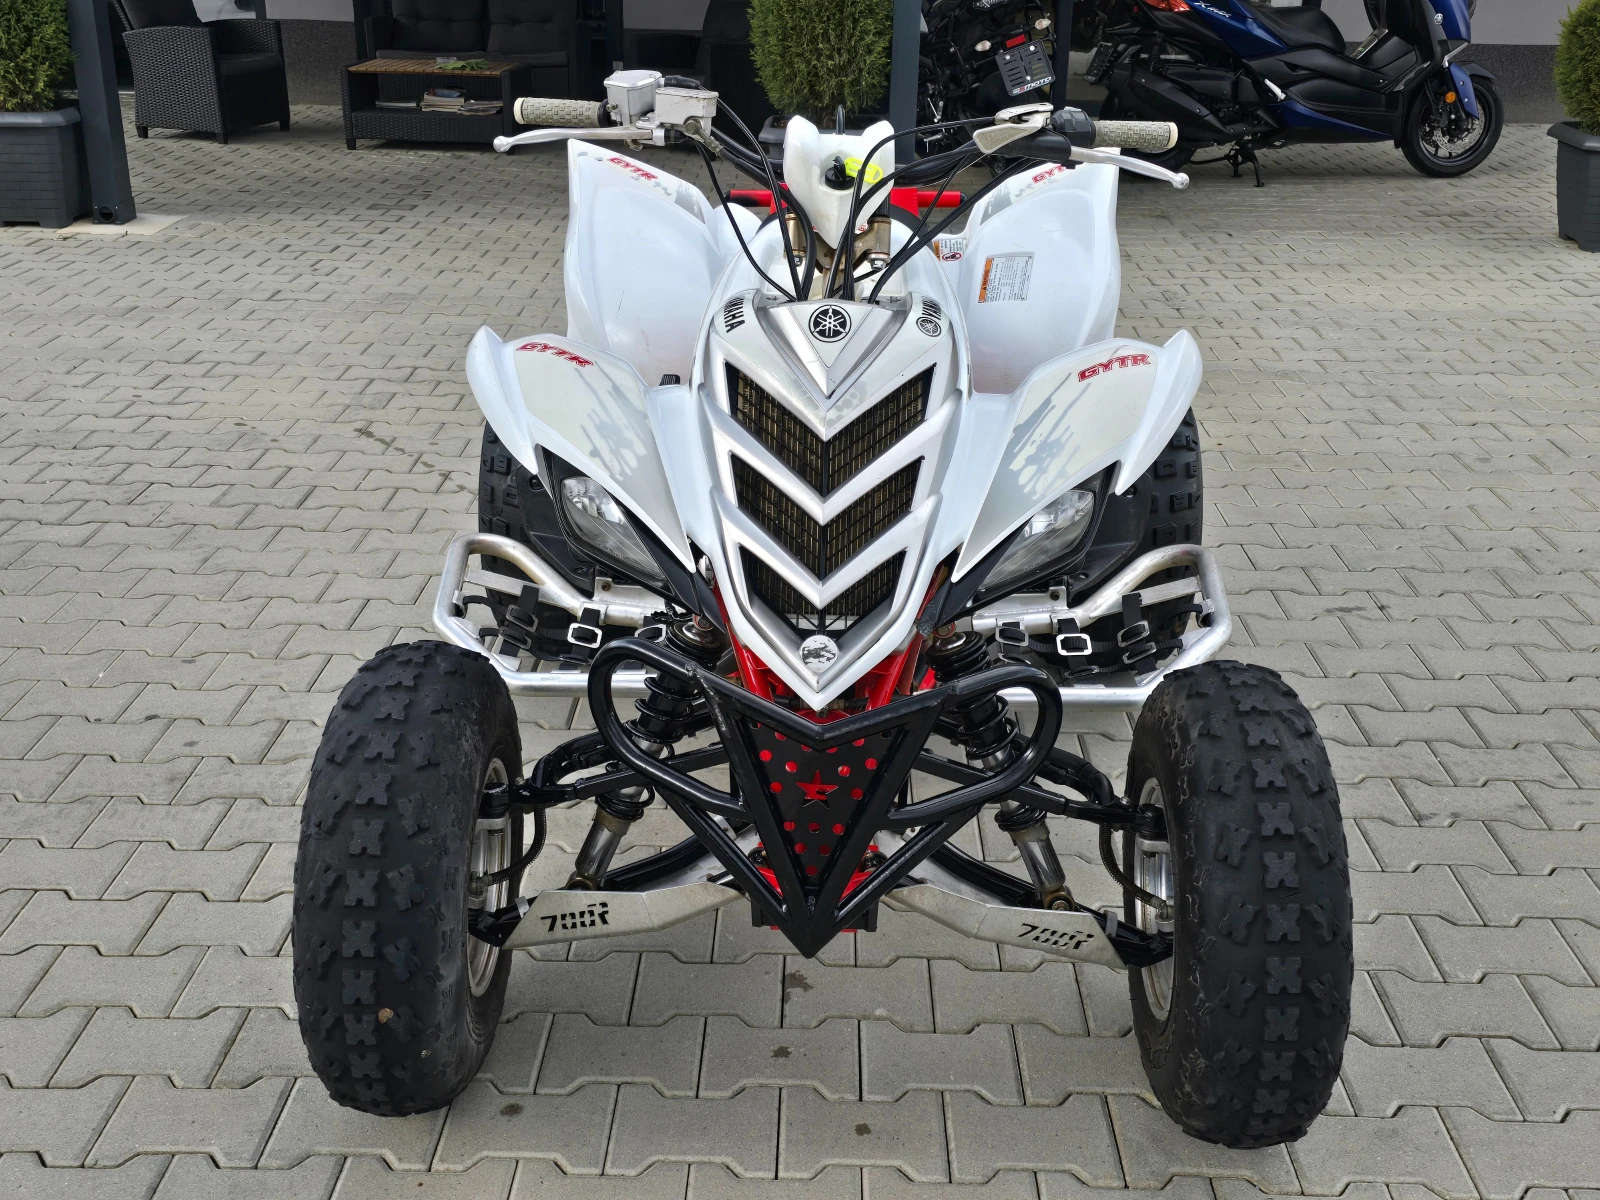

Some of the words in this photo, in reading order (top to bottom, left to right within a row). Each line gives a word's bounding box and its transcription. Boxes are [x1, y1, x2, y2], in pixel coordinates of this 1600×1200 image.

[1032, 165, 1066, 184] GYT
[516, 342, 594, 368] GYTR
[1078, 354, 1151, 382] GYTR
[540, 902, 609, 932] 700R
